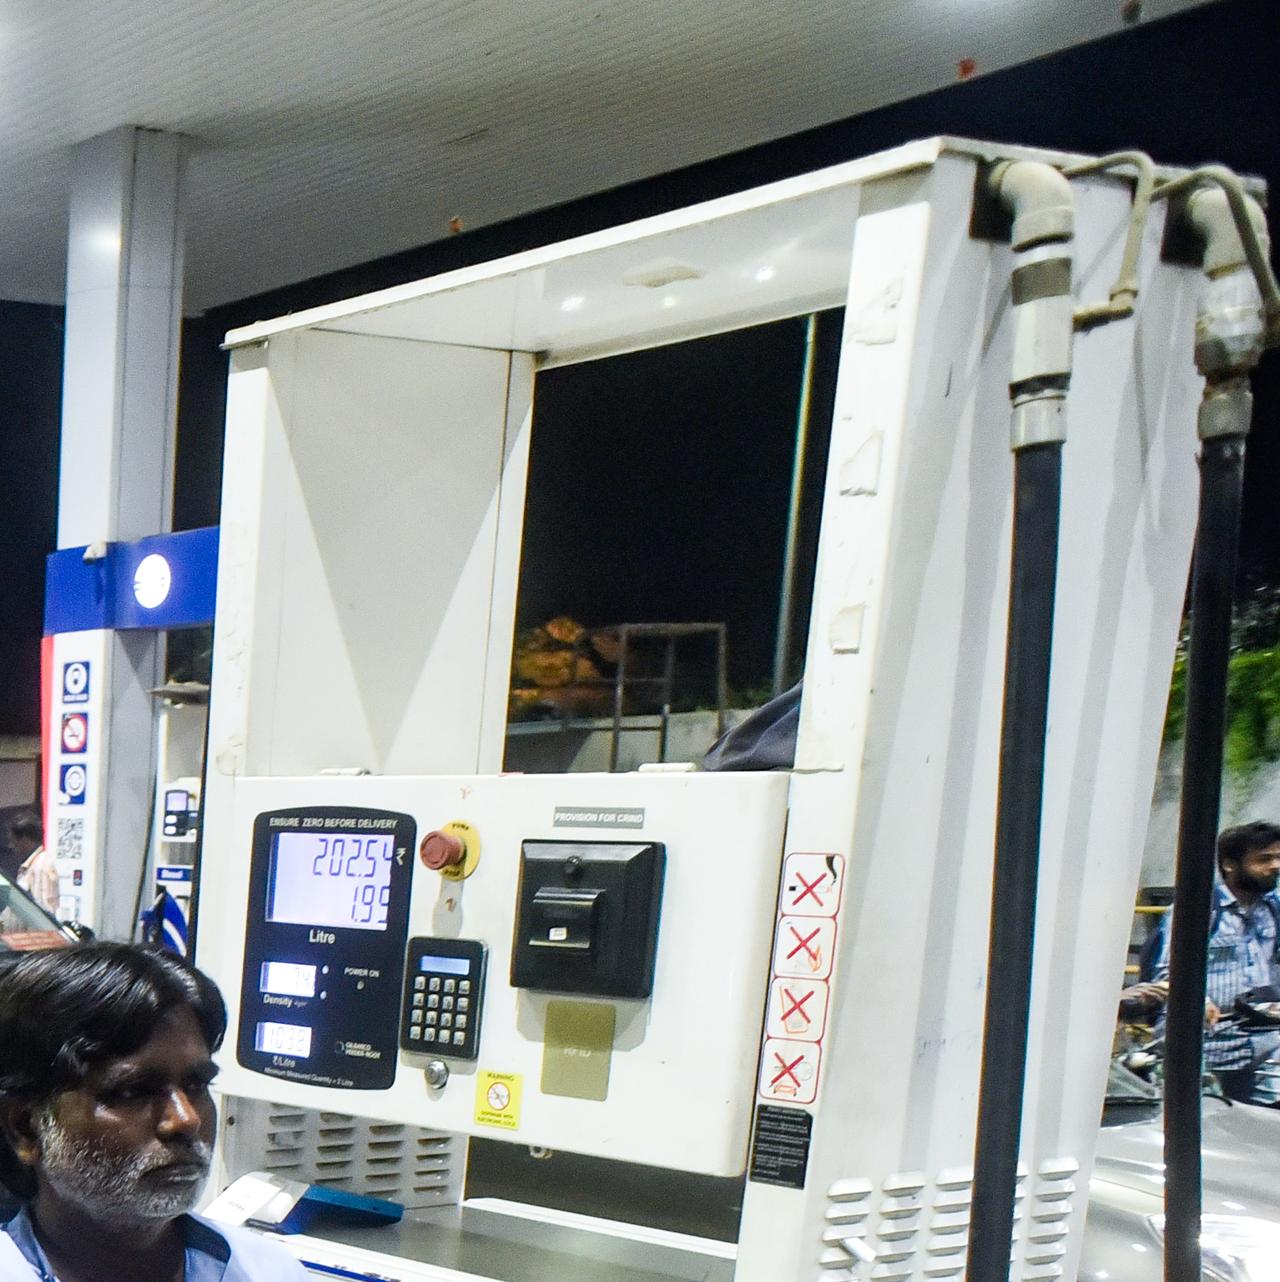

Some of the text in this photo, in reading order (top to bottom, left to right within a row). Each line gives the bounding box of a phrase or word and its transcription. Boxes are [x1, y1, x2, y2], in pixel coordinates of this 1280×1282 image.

[302, 818, 323, 828] ZERO
[324, 818, 357, 829] BEFORE
[357, 819, 398, 829] DELIVERY
[309, 929, 335, 944] Litre
[343, 966, 380, 978] POWER ON
[263, 994, 294, 1009] Density
